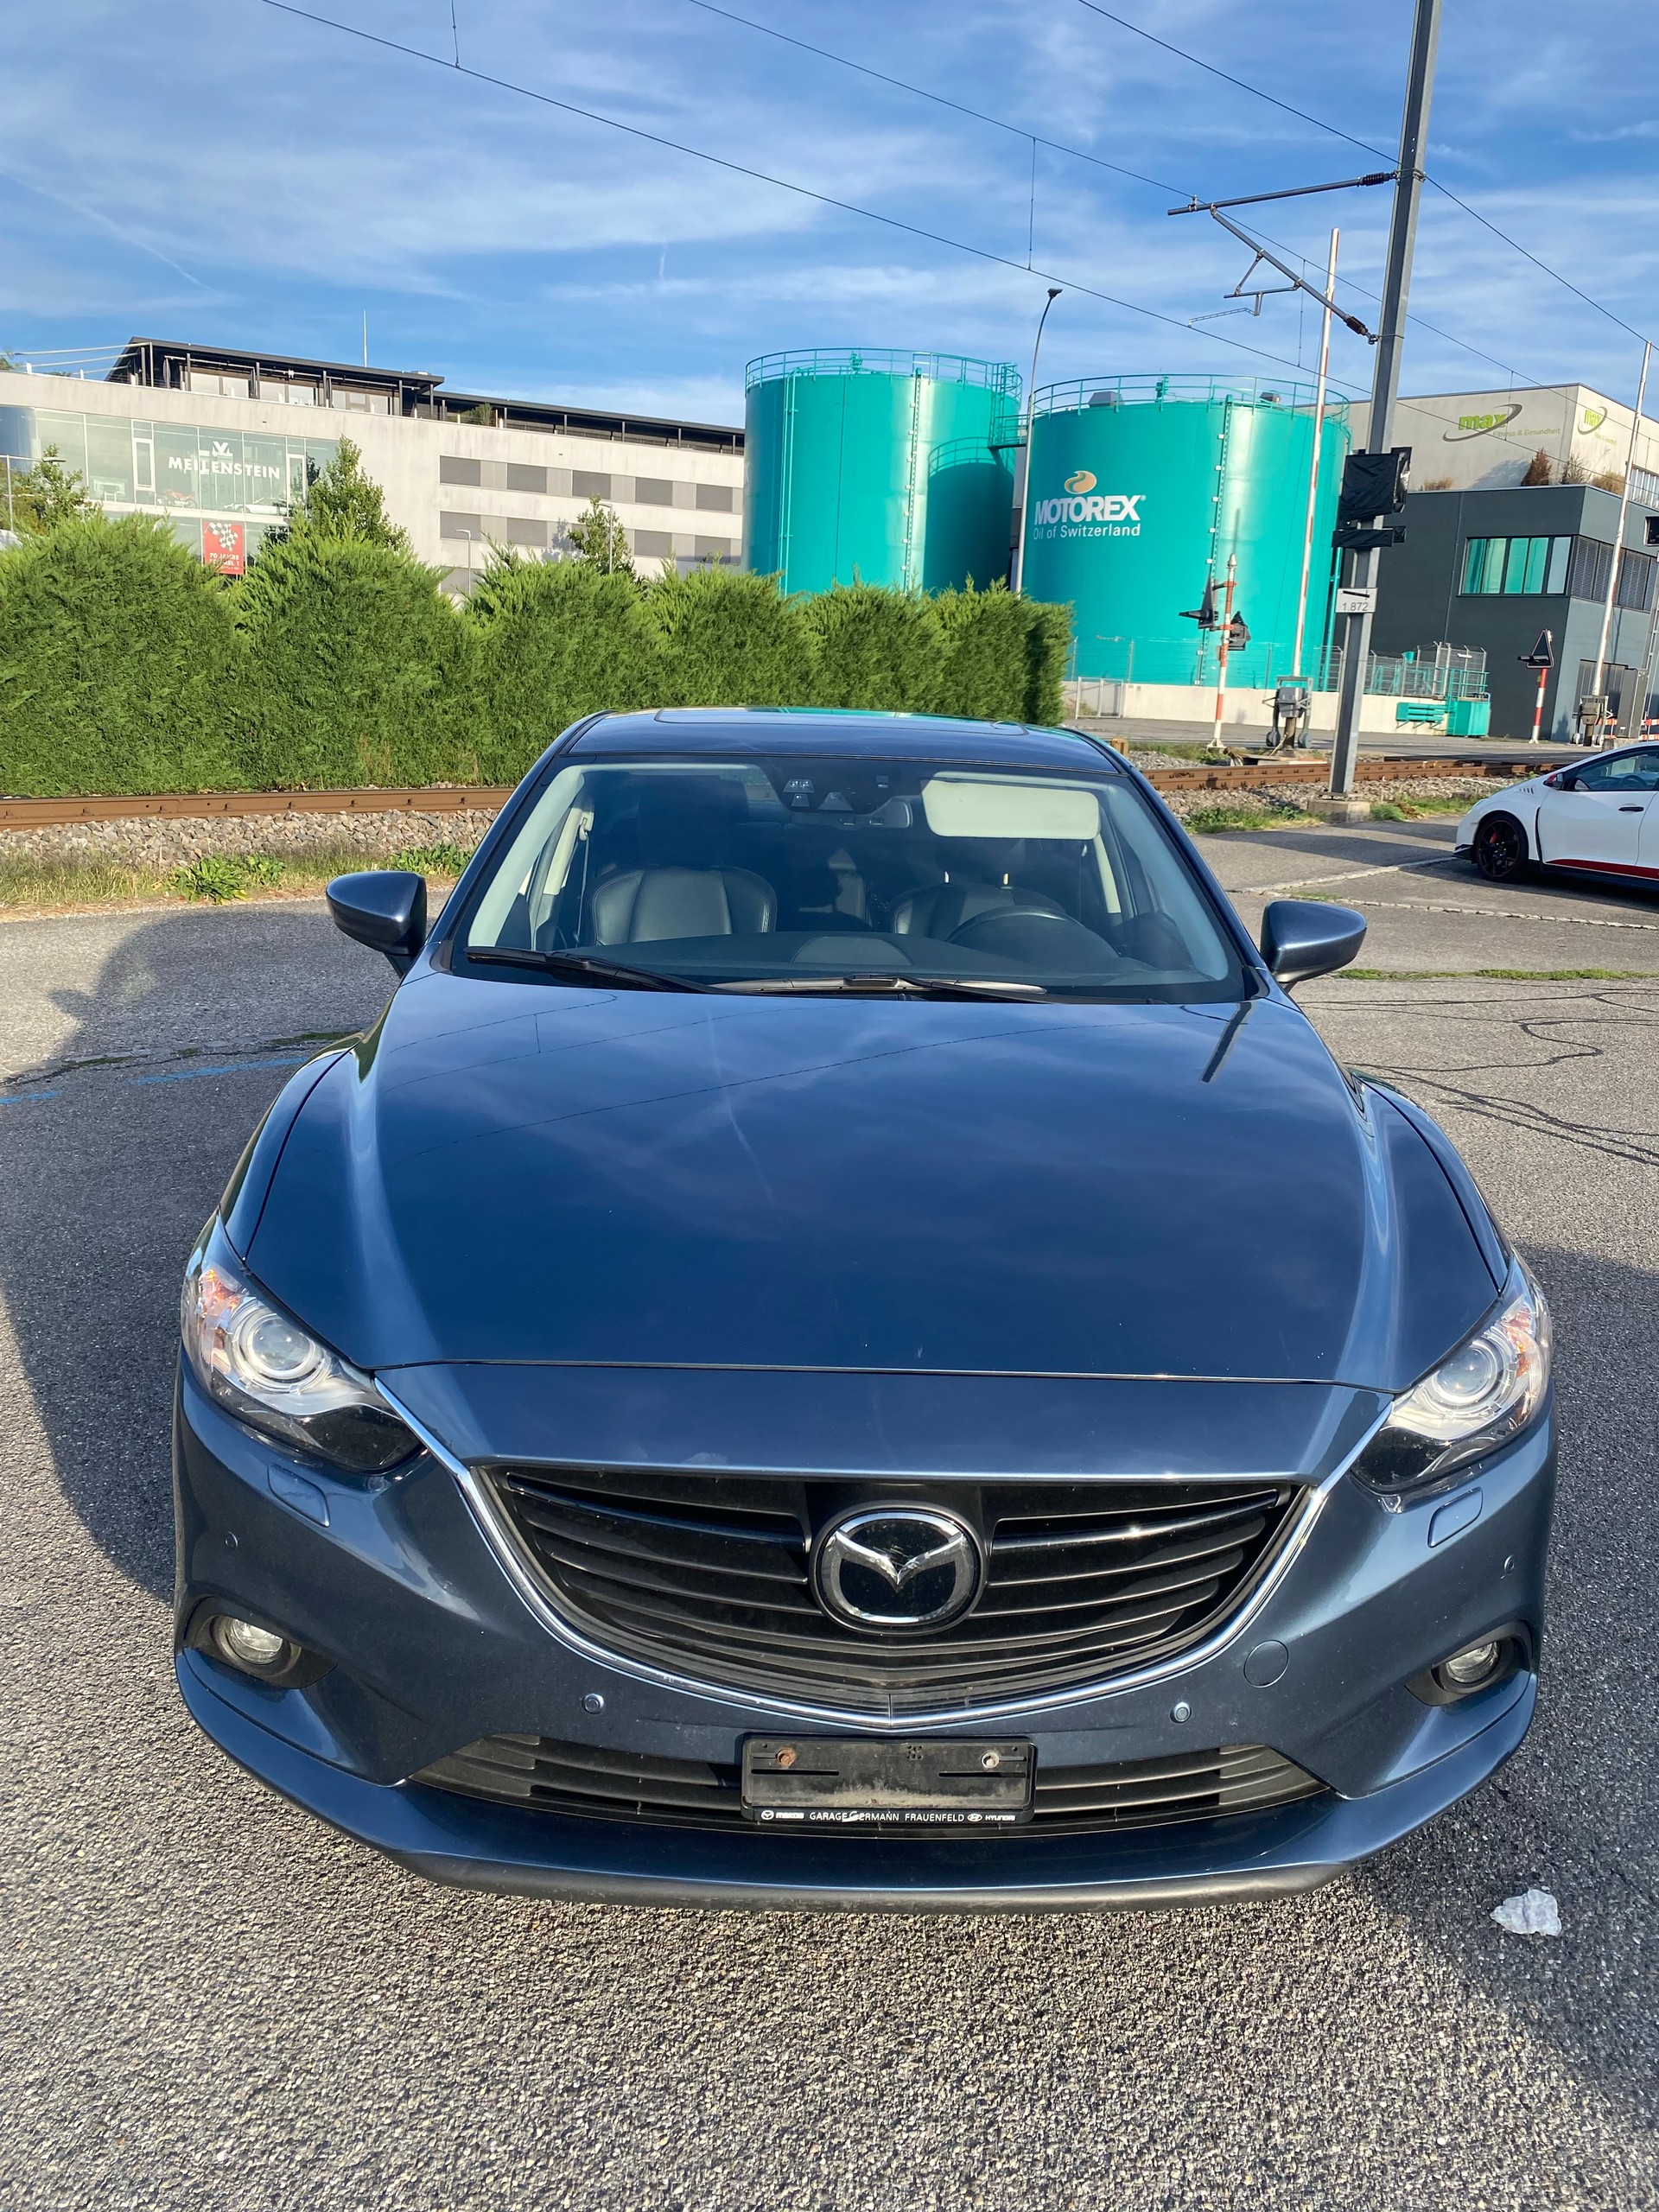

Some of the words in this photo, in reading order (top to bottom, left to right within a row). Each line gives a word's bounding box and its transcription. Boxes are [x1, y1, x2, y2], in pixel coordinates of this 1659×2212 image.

[1523, 428, 1560, 436] Gesundheit
[168, 456, 280, 480] MEILENSTEIN
[1034, 495, 1141, 525] MOTOREX
[1033, 527, 1044, 540] Oil
[1046, 525, 1058, 539] of
[1059, 523, 1141, 538] Switzerland
[1342, 601, 1369, 612] 1.872
[809, 1811, 848, 1821] GARAGE
[846, 1810, 899, 1821] GERMANN
[905, 1813, 964, 1822] FRAUENFELD
